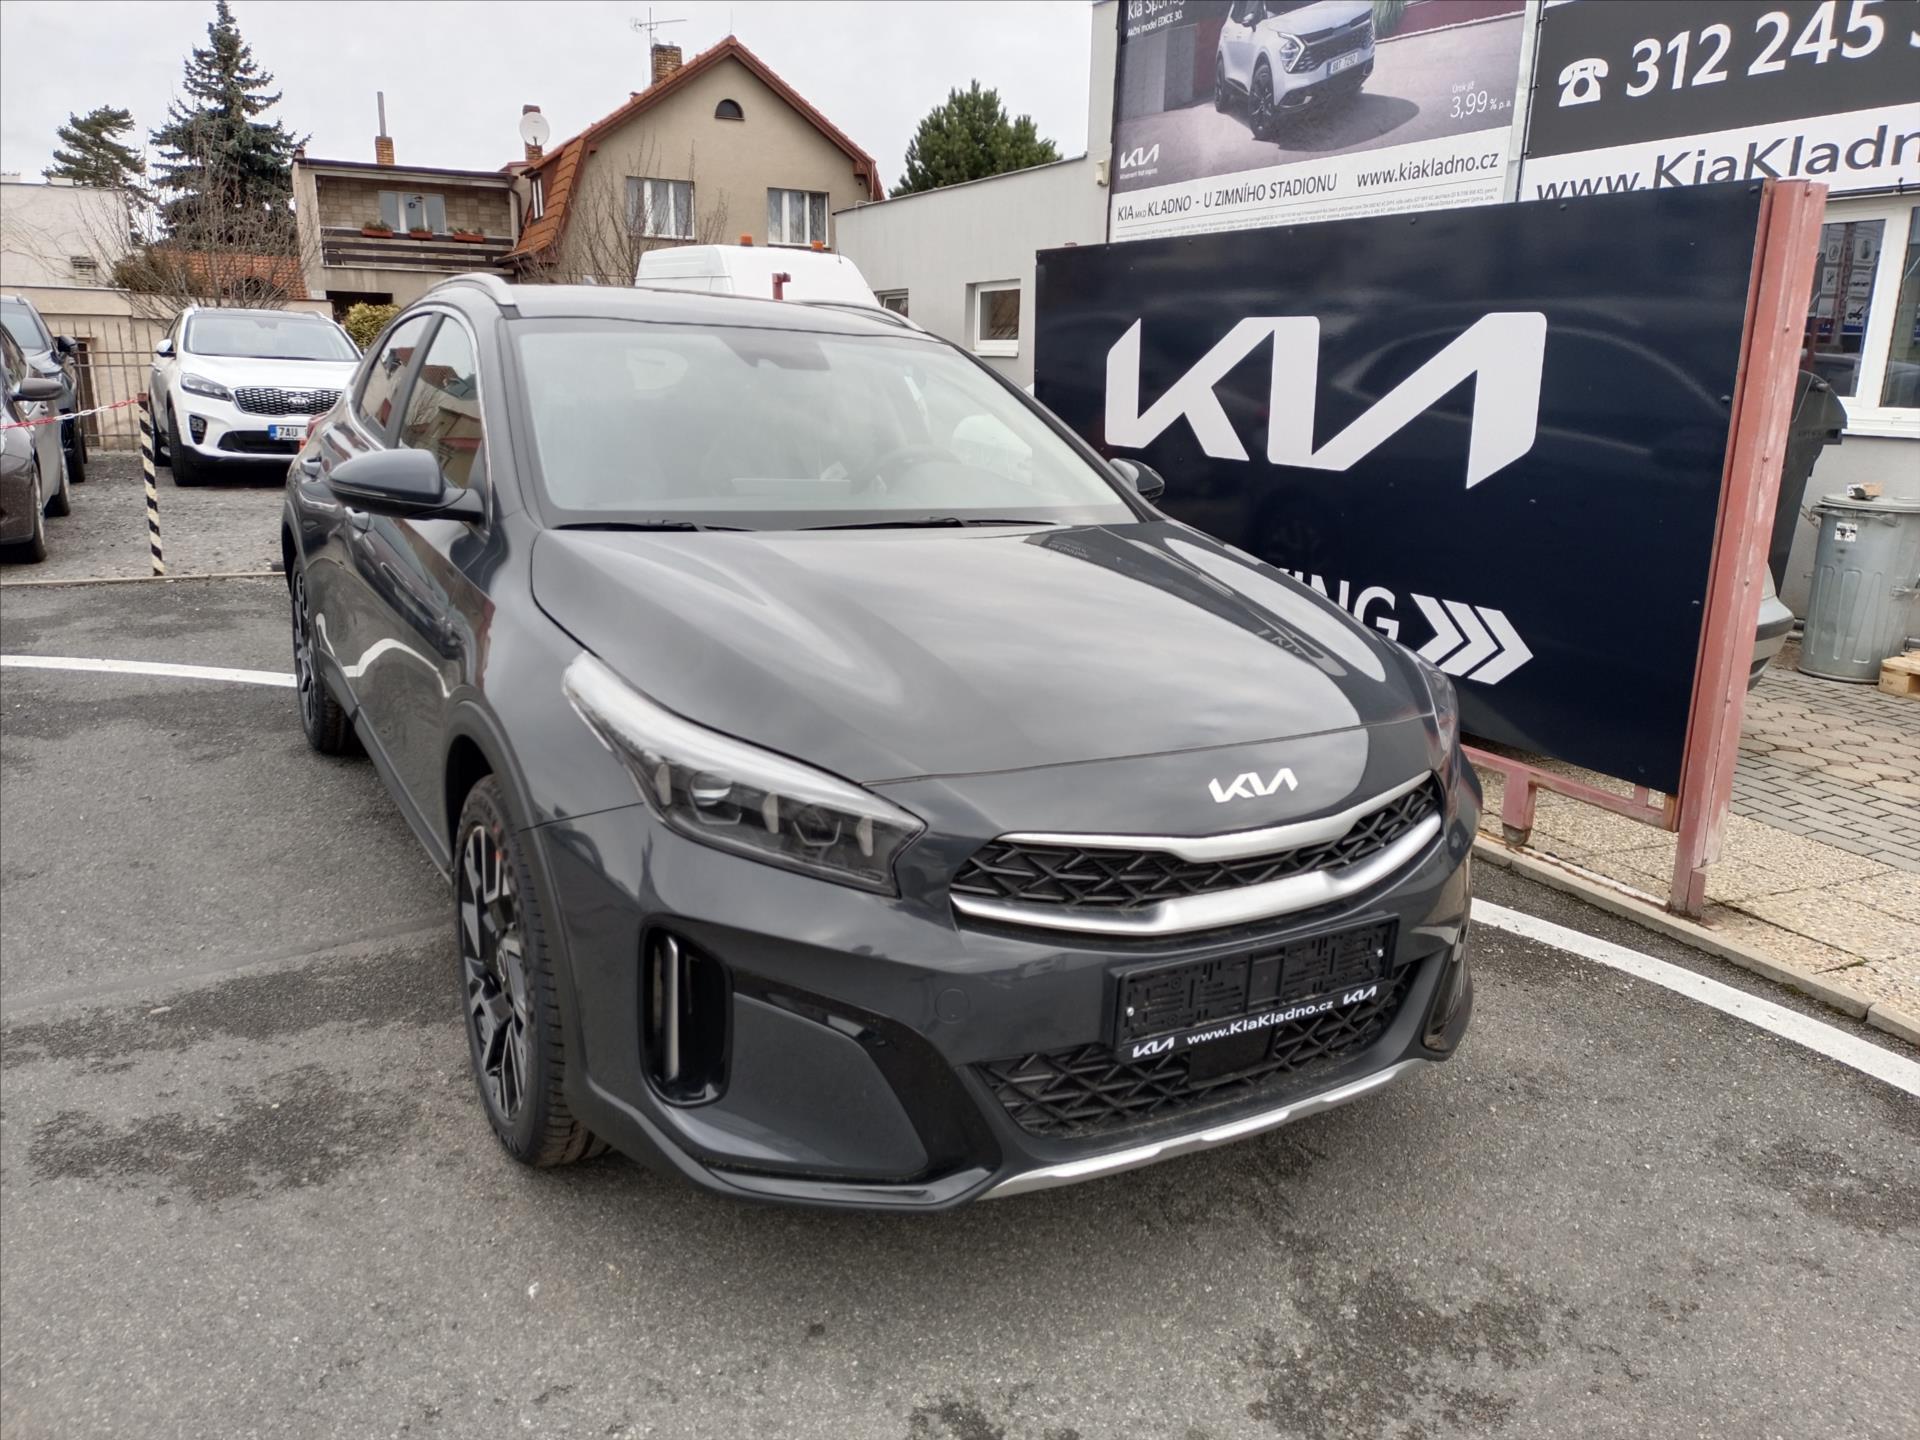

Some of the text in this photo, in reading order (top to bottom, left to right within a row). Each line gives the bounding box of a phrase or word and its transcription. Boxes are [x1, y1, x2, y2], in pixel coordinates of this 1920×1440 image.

[1626, 0, 1885, 98] 312 245
[1450, 90, 1487, 119] 3,99
[1117, 205, 1134, 221] KIA
[1147, 195, 1192, 217] KLADNO
[1204, 192, 1212, 208] U
[1215, 182, 1266, 206] ZIMNÍHO
[1269, 173, 1338, 200] STADIONU
[1357, 153, 1499, 187] www.kiakladno.cz
[1120, 143, 1159, 169] KIA
[1104, 312, 1547, 490] KIA
[1208, 767, 1299, 804] KIA
[1132, 1036, 1175, 1058] KIA
[1342, 985, 1377, 1006] KIA
